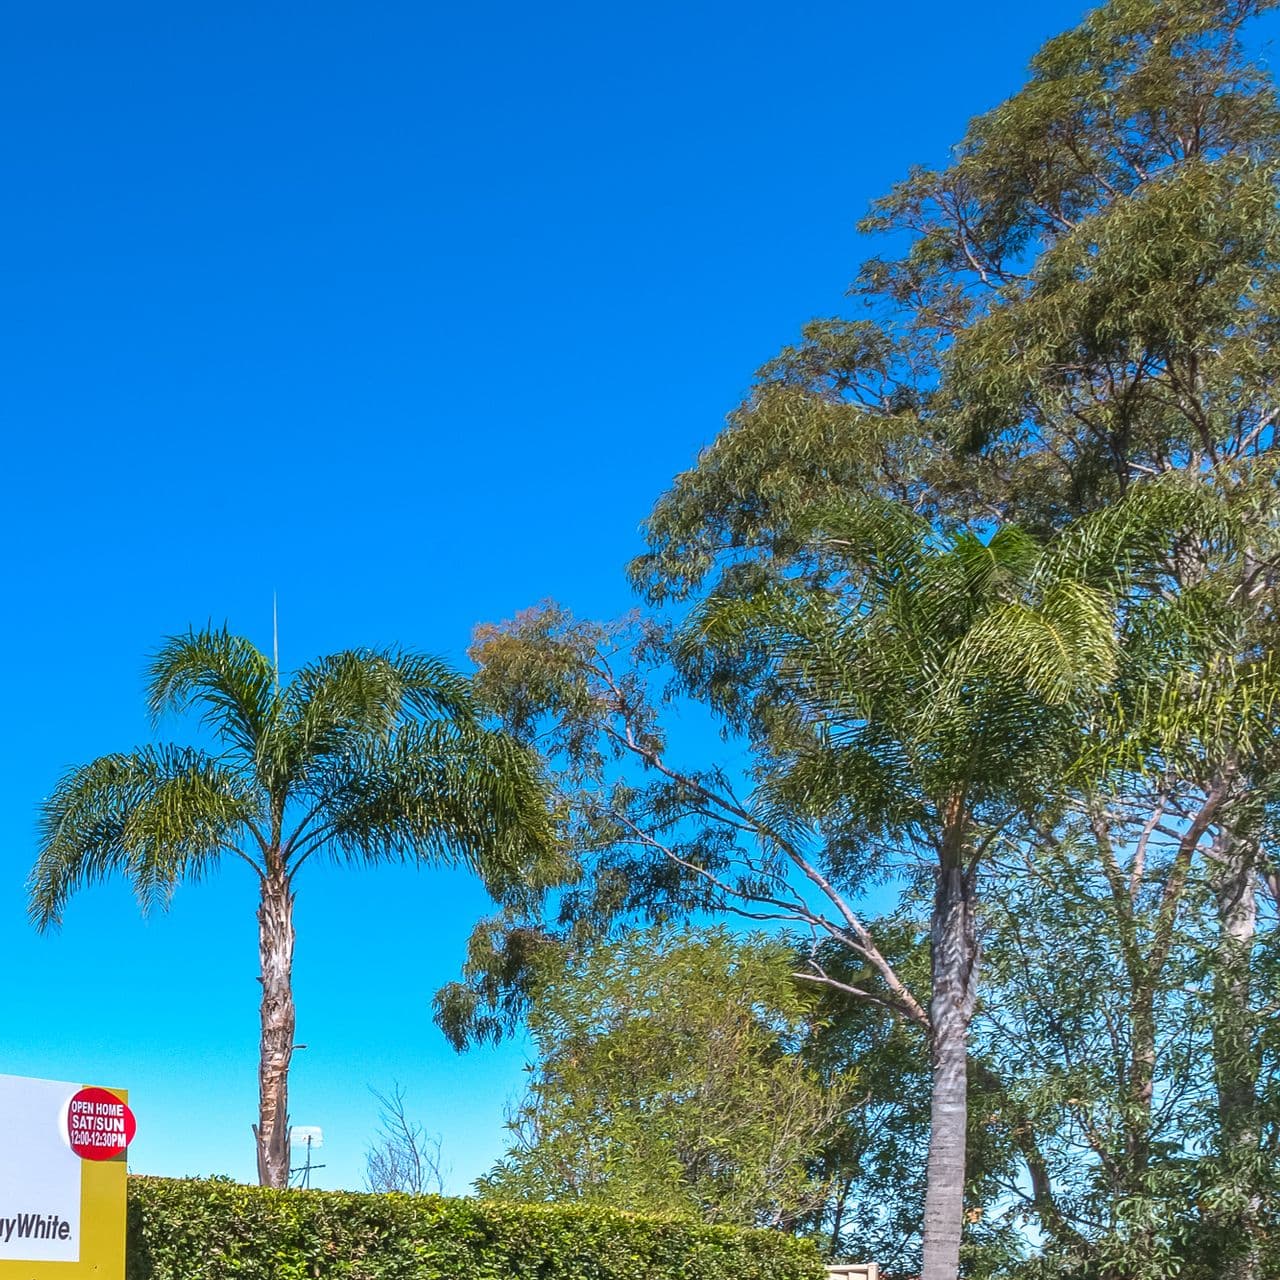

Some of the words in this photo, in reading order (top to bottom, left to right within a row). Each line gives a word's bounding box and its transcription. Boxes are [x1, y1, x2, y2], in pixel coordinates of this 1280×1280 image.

[71, 1100, 94, 1114] OPEN
[96, 1103, 124, 1116] HOME
[72, 1115, 125, 1132] SAT/SUN
[71, 1130, 126, 1147] 12:00-12:30PM
